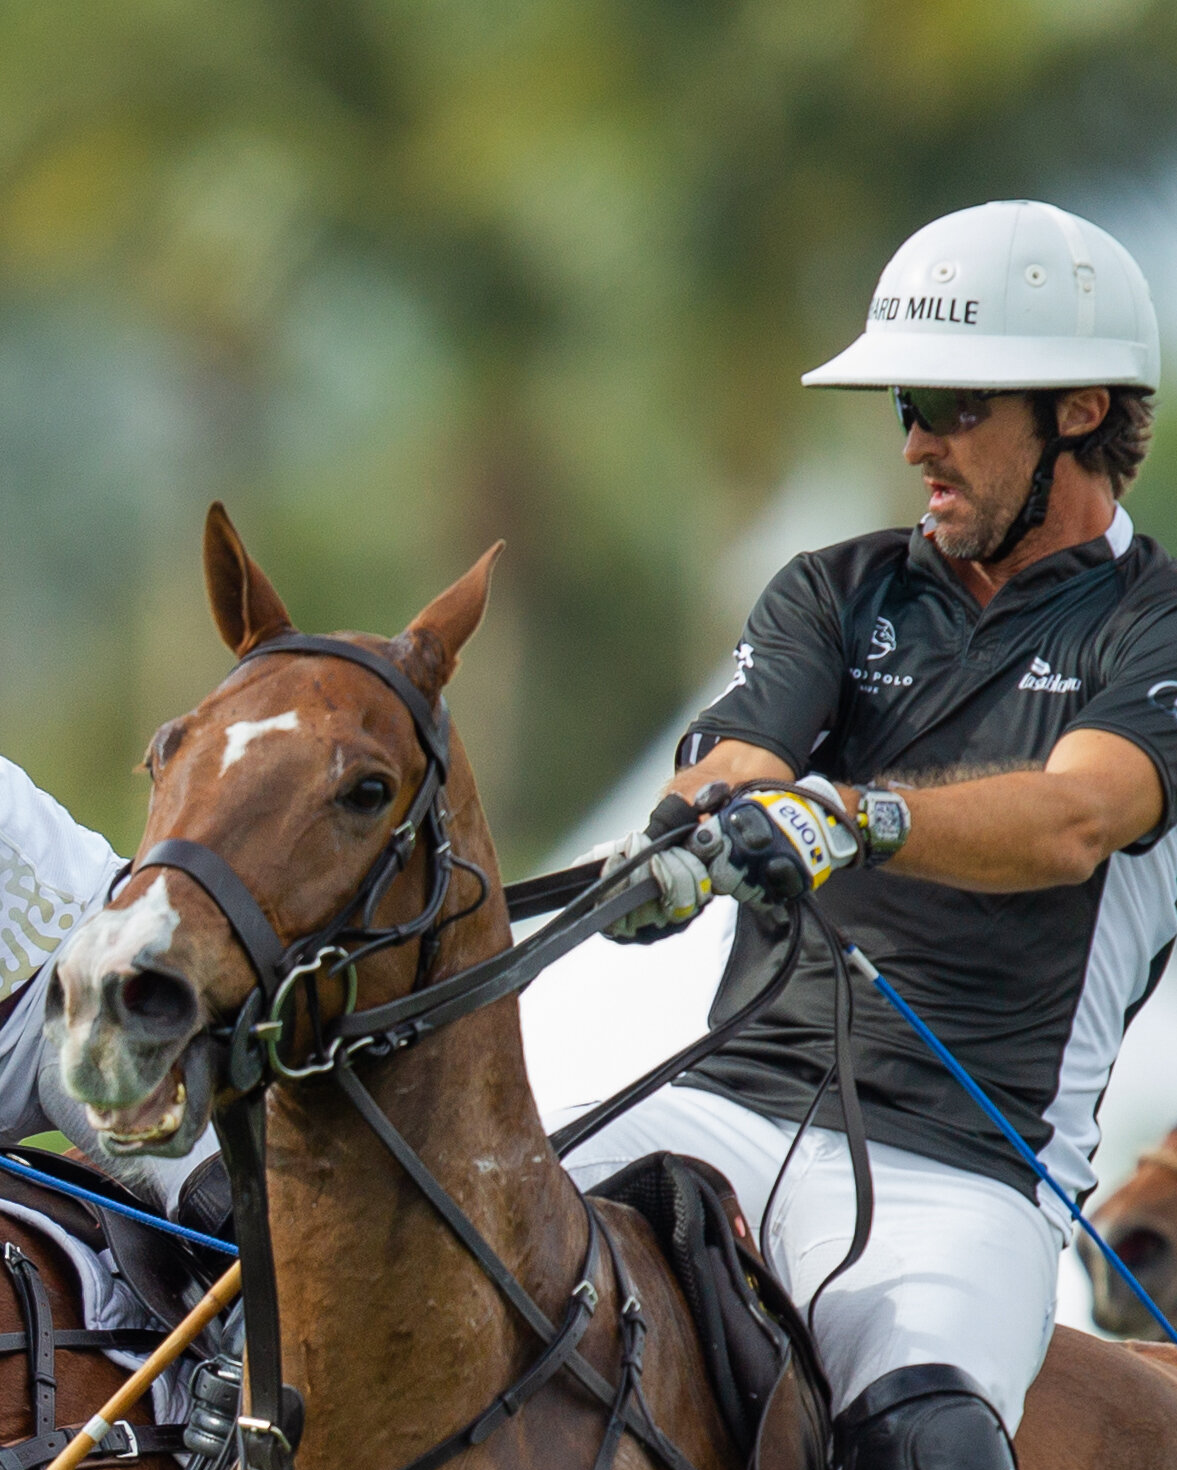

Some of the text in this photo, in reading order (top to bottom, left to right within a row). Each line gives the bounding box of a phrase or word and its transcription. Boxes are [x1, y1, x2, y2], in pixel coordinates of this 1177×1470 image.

[870, 296, 979, 325] ARD MILLE
[872, 671, 914, 687] POLO
[779, 804, 817, 846] ona
